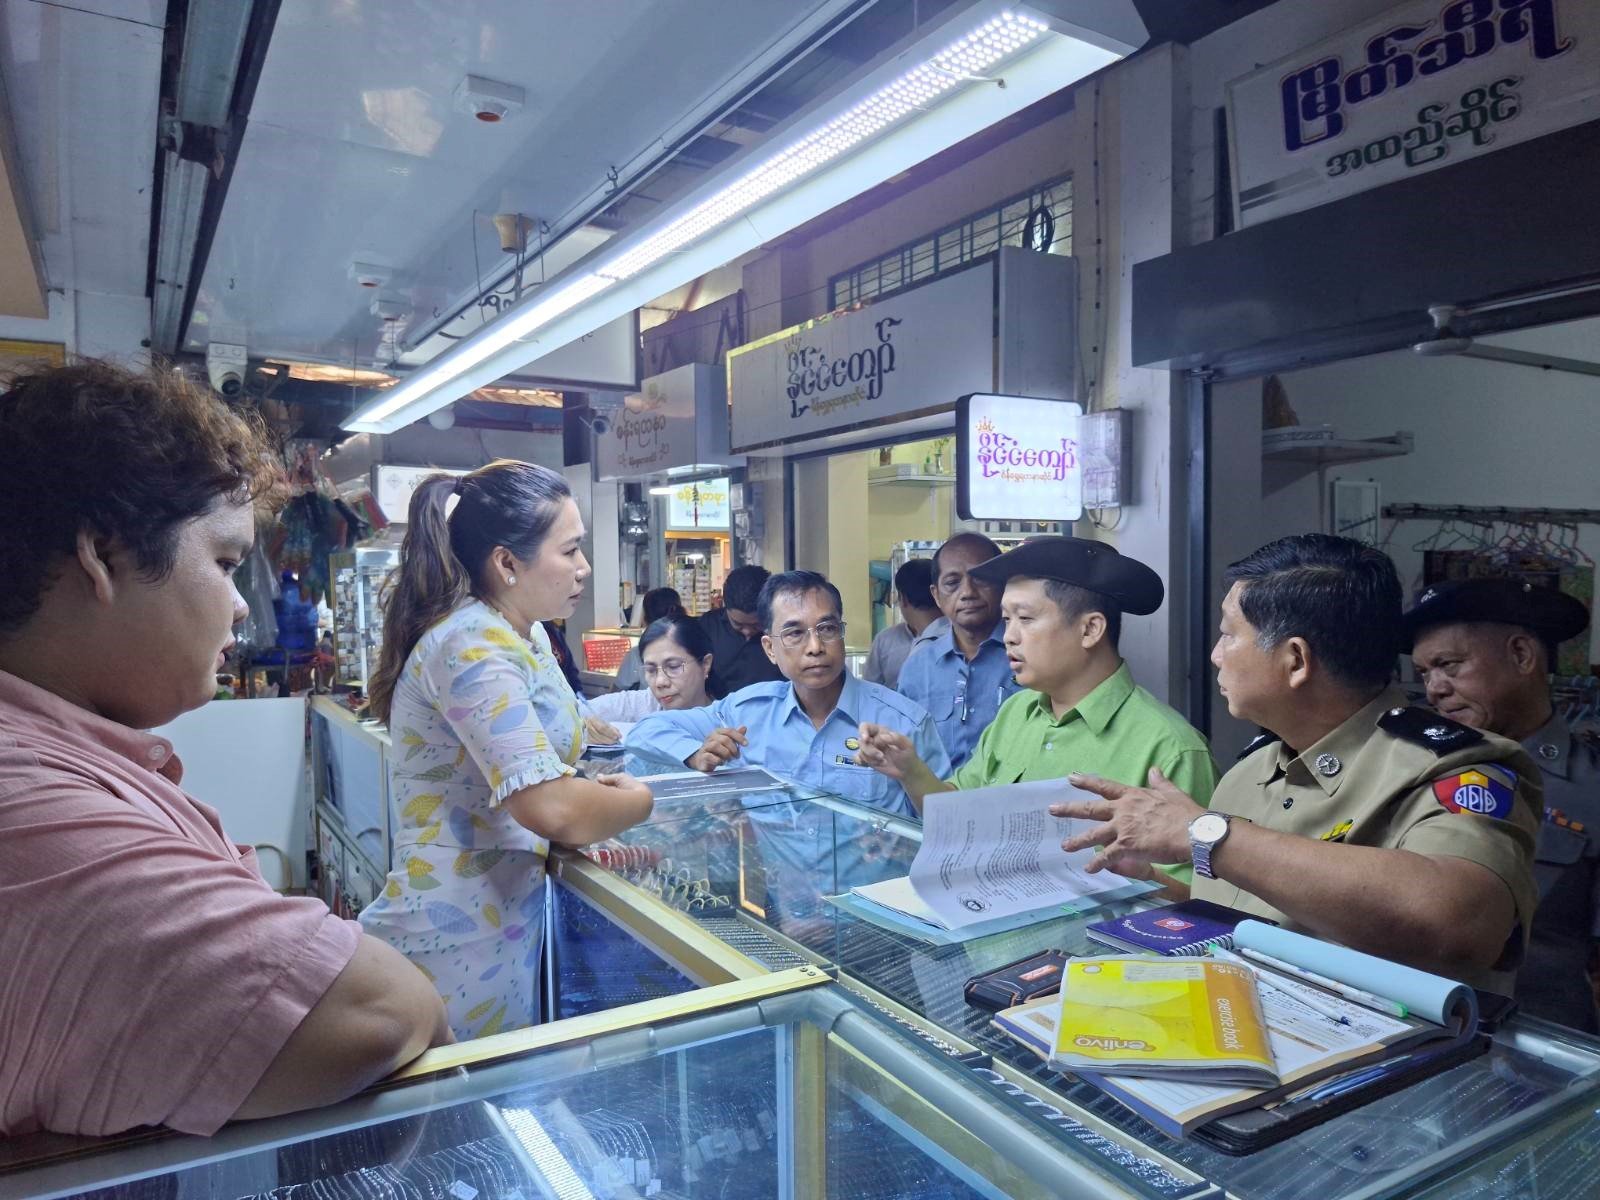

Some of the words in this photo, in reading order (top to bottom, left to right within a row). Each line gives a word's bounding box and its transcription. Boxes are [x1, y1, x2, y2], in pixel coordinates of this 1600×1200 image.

[1325, 75, 1524, 177] အထည်ဆိုင်
[786, 316, 903, 419] နိုင်ငံကျော်
[977, 432, 1077, 481] နိုင်ငံကျော်
[1217, 998, 1238, 1027] exercise
[1076, 1036, 1147, 1051] enlivo
[1222, 1026, 1244, 1050] book
